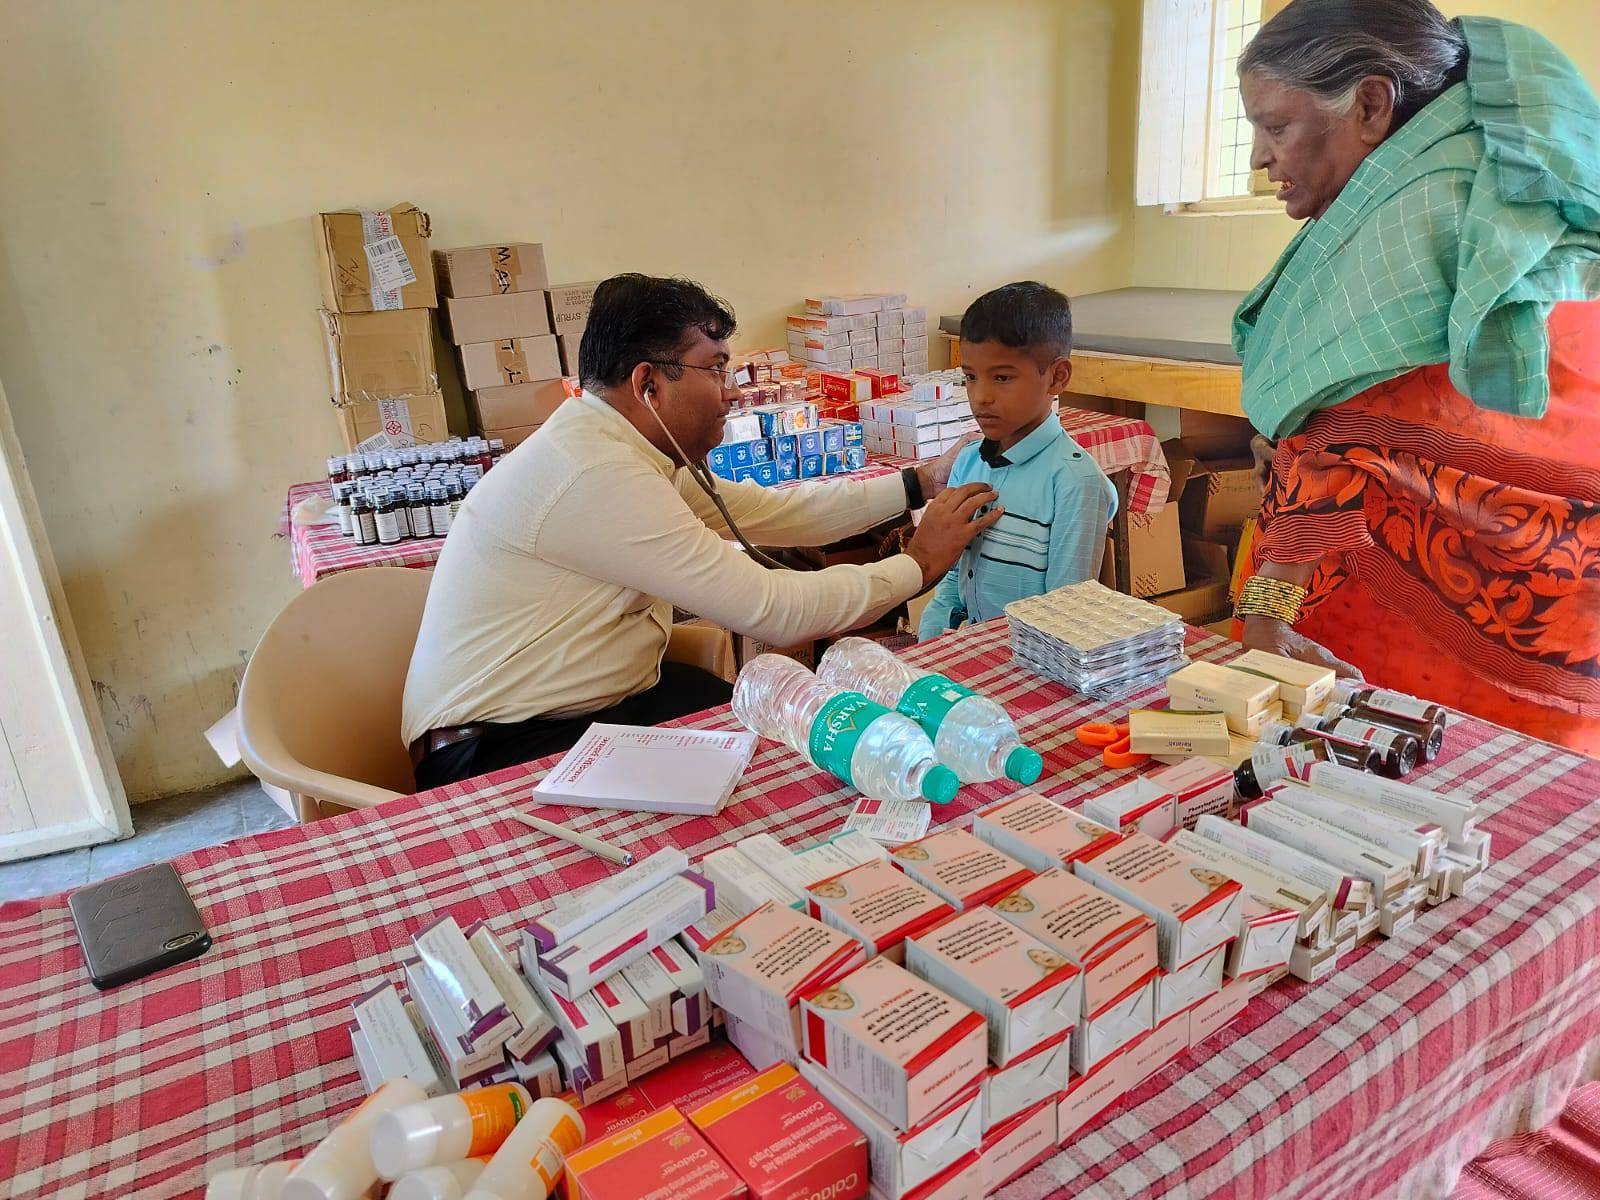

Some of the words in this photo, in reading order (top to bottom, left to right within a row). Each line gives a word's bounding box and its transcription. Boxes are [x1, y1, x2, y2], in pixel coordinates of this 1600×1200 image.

[555, 311, 581, 323] SYRUP
[823, 701, 867, 750] VARSHA
[701, 1057, 741, 1082] Coldover
[603, 1107, 648, 1134] Coldover
[779, 1100, 826, 1128] Coldover
[659, 1146, 709, 1176] Coldover
